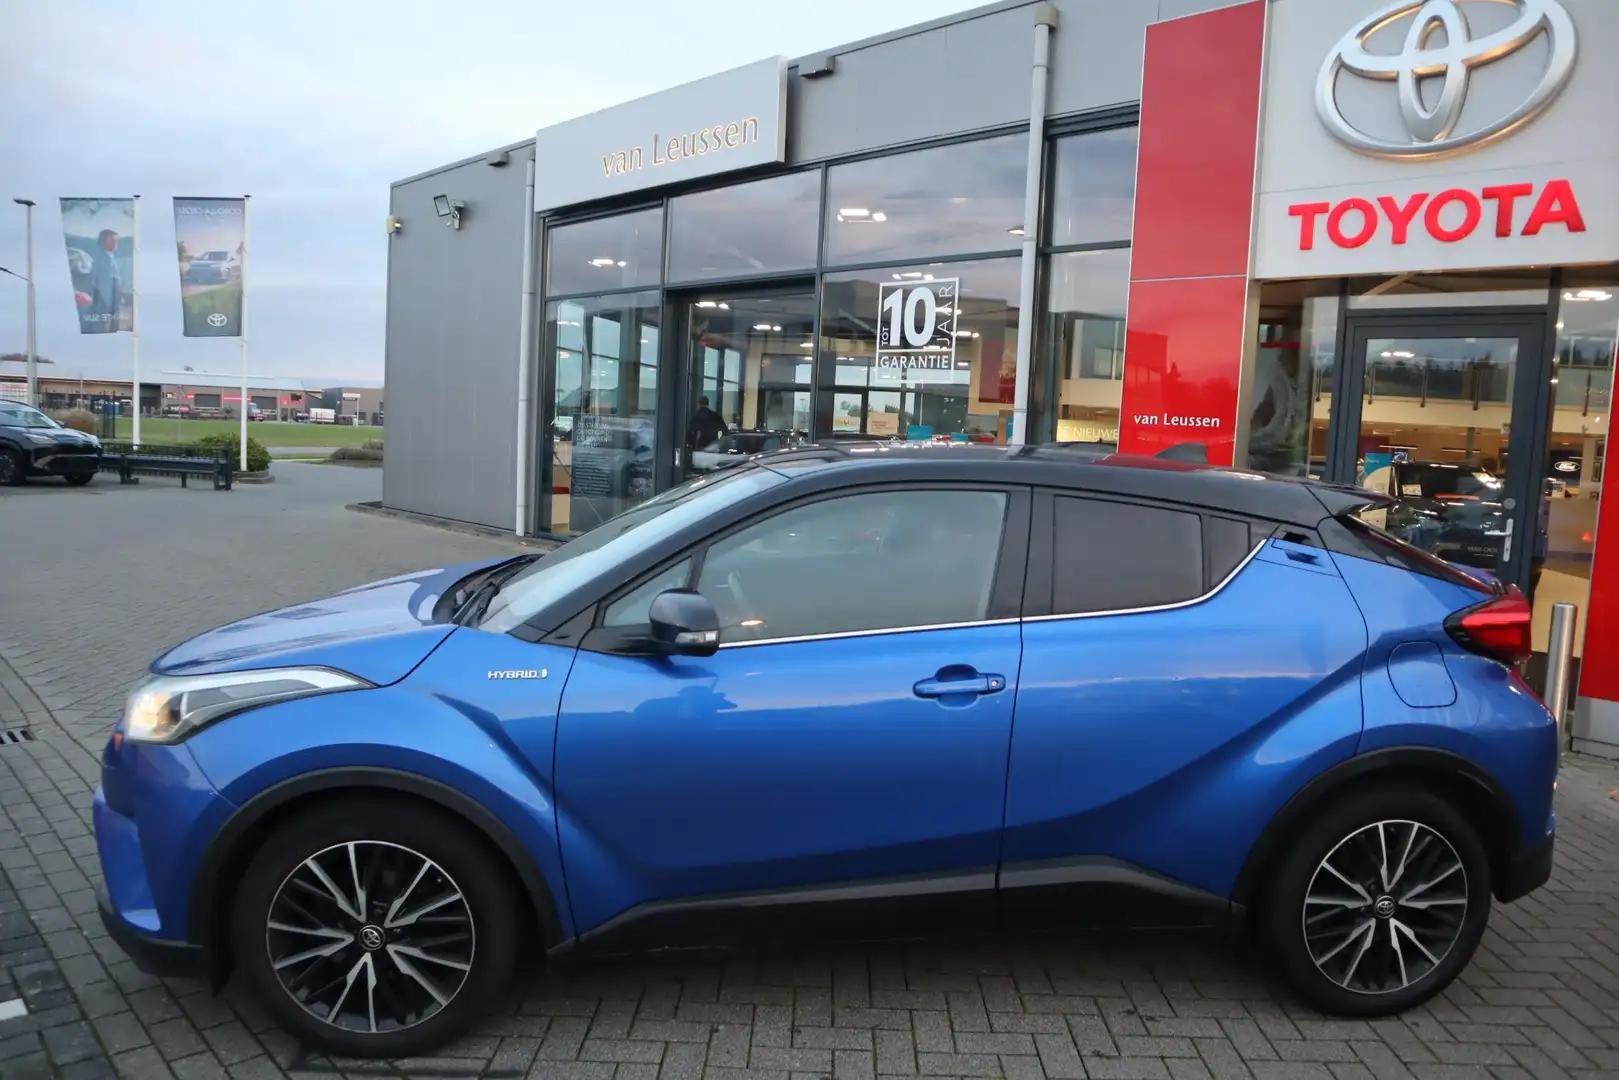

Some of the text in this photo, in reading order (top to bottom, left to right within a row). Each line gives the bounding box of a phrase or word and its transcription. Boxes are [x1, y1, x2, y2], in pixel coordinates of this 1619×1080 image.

[602, 116, 759, 178] van Leussen
[1288, 178, 1587, 251] TOYOTA
[883, 287, 936, 346] 10
[936, 284, 953, 346] JAAR
[881, 326, 889, 347] TOT
[880, 355, 949, 369] GARANTIE
[1133, 411, 1221, 428] van Leussen
[1073, 427, 1118, 440] NIEUWE
[487, 669, 538, 679] HYBRID
